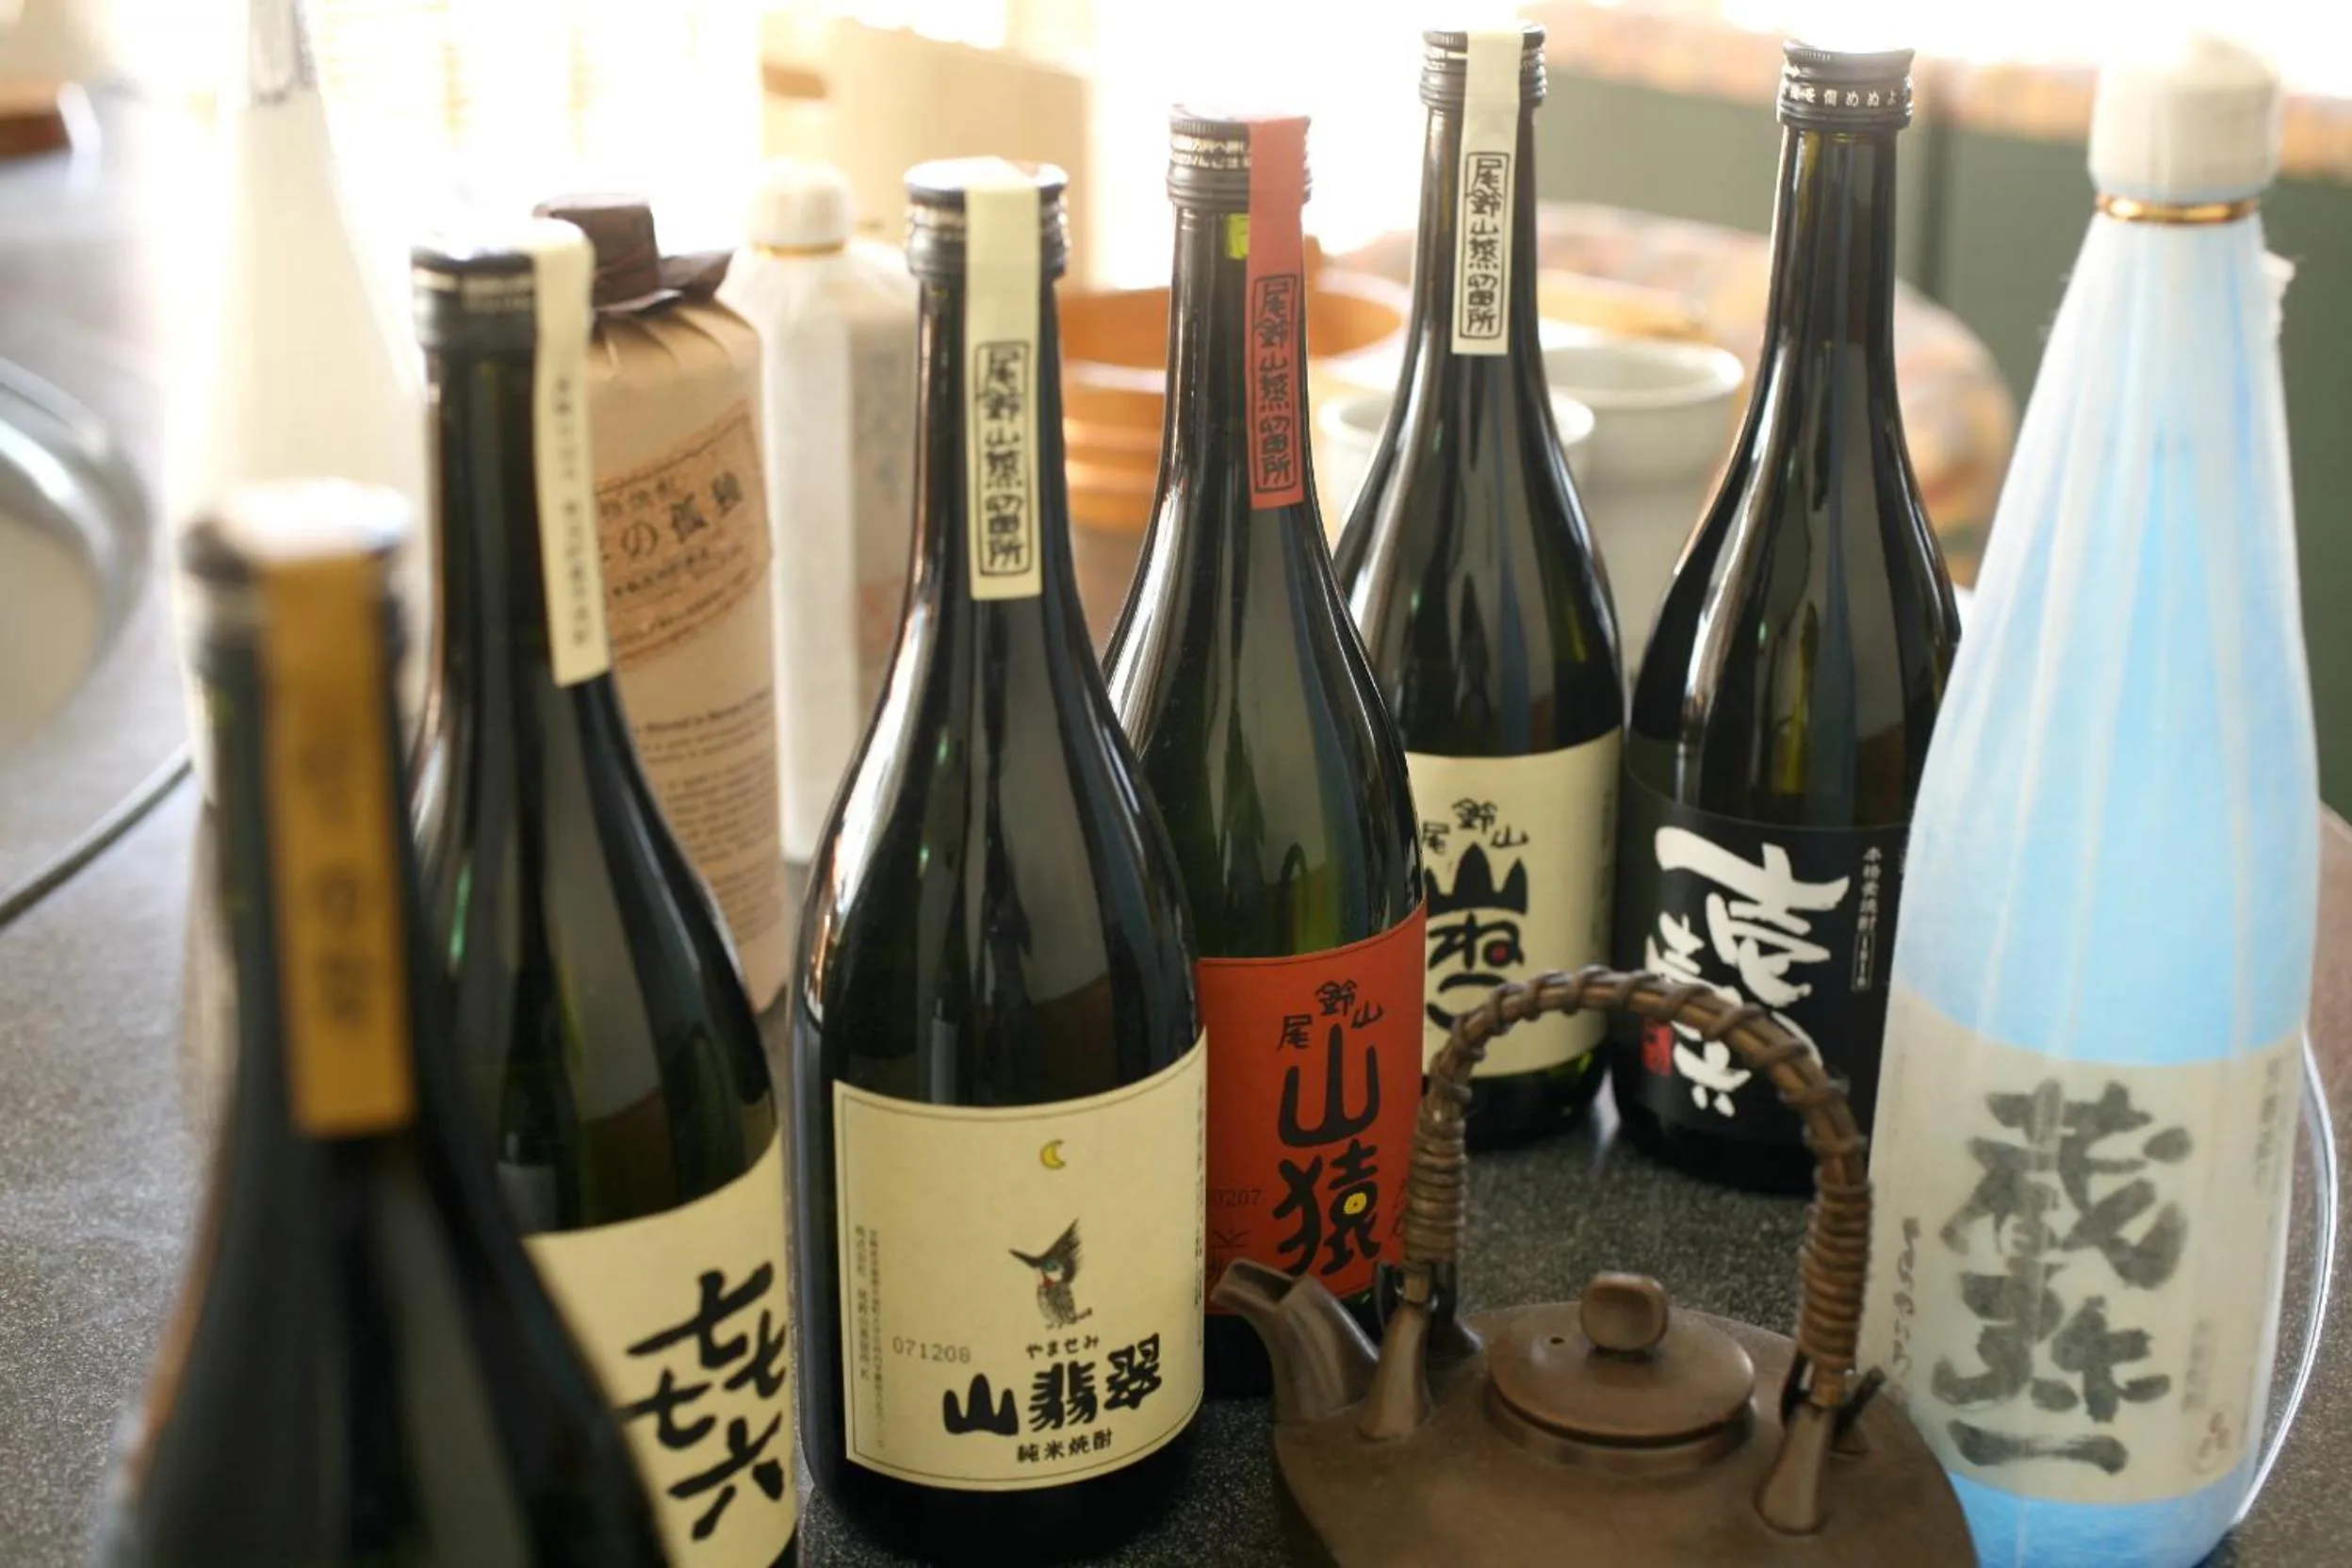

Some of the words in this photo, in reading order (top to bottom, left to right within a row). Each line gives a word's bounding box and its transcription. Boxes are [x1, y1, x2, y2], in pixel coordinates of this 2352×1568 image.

[891, 1336, 972, 1364] 071208
[1025, 1334, 1100, 1360] やませみ
[942, 1331, 1163, 1436] 山翡翠
[1017, 1427, 1113, 1462] 純米焼酎
